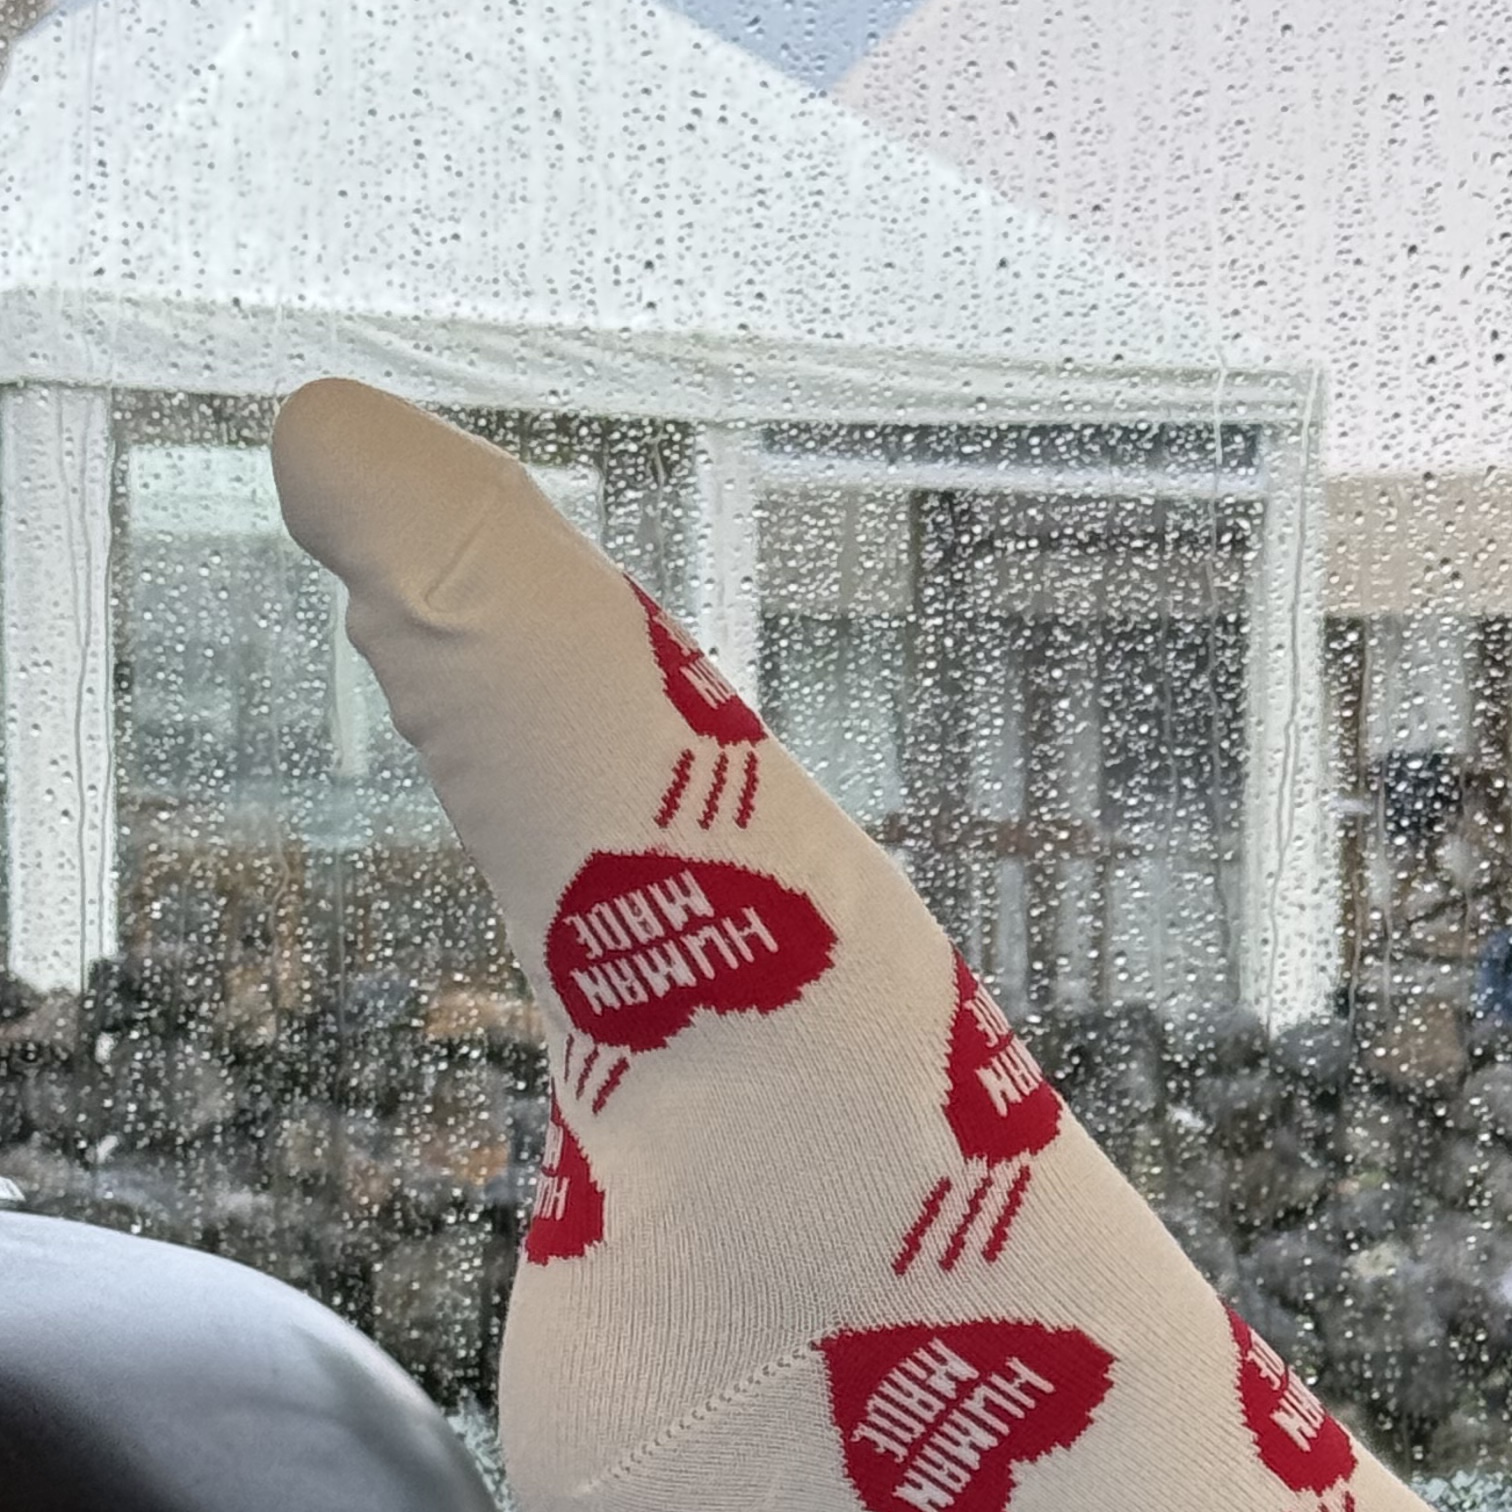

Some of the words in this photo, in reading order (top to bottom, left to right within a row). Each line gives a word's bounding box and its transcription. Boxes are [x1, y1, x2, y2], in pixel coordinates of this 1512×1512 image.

[563, 869, 715, 960] MADE
[571, 906, 778, 1016] HUMAN
[850, 1337, 980, 1463] MADE
